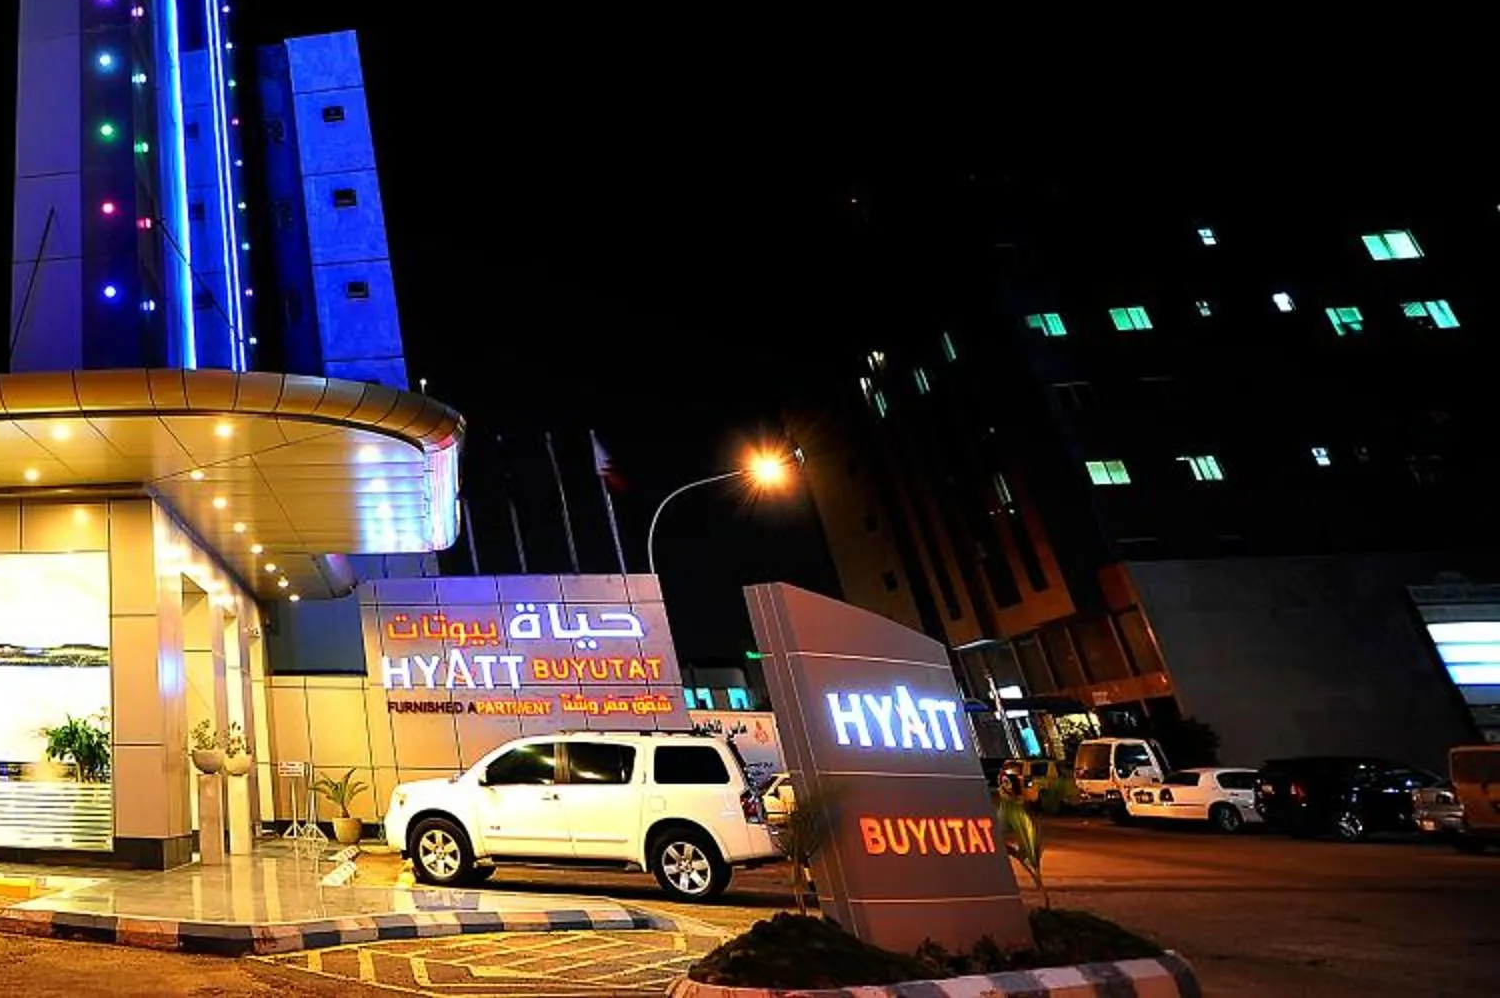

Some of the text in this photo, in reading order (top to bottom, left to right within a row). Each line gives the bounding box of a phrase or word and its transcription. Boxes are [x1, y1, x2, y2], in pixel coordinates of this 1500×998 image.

[387, 602, 645, 650] حياة بيوتات
[381, 649, 662, 689] HYATT BUYUTAT
[387, 701, 551, 715] FURNISHED APARTMENT
[631, 693, 674, 715] شقق
[827, 684, 964, 751] HYATT
[859, 817, 996, 856] BUYUTAT
